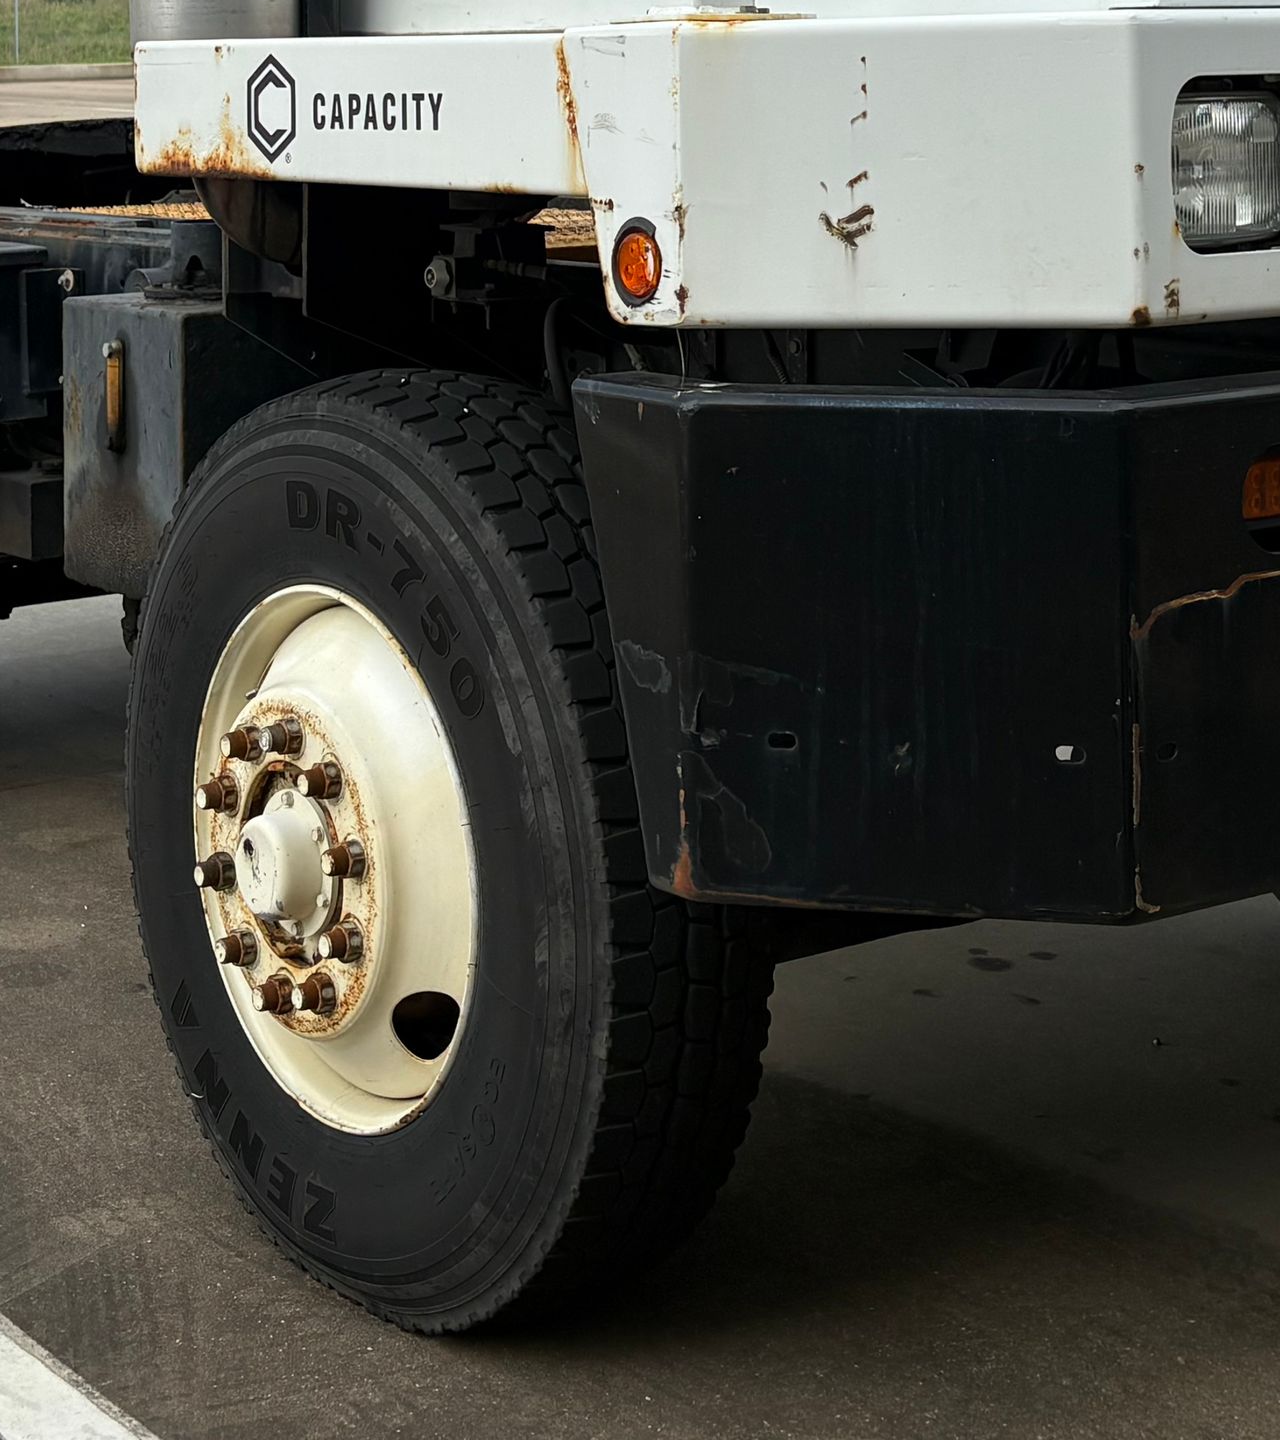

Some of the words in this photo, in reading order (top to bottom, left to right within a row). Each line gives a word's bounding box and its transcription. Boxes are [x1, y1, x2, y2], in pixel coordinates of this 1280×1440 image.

[312, 91, 444, 132] CAPACITY
[285, 479, 485, 719] DR-750
[170, 978, 338, 1246] ZENNA
